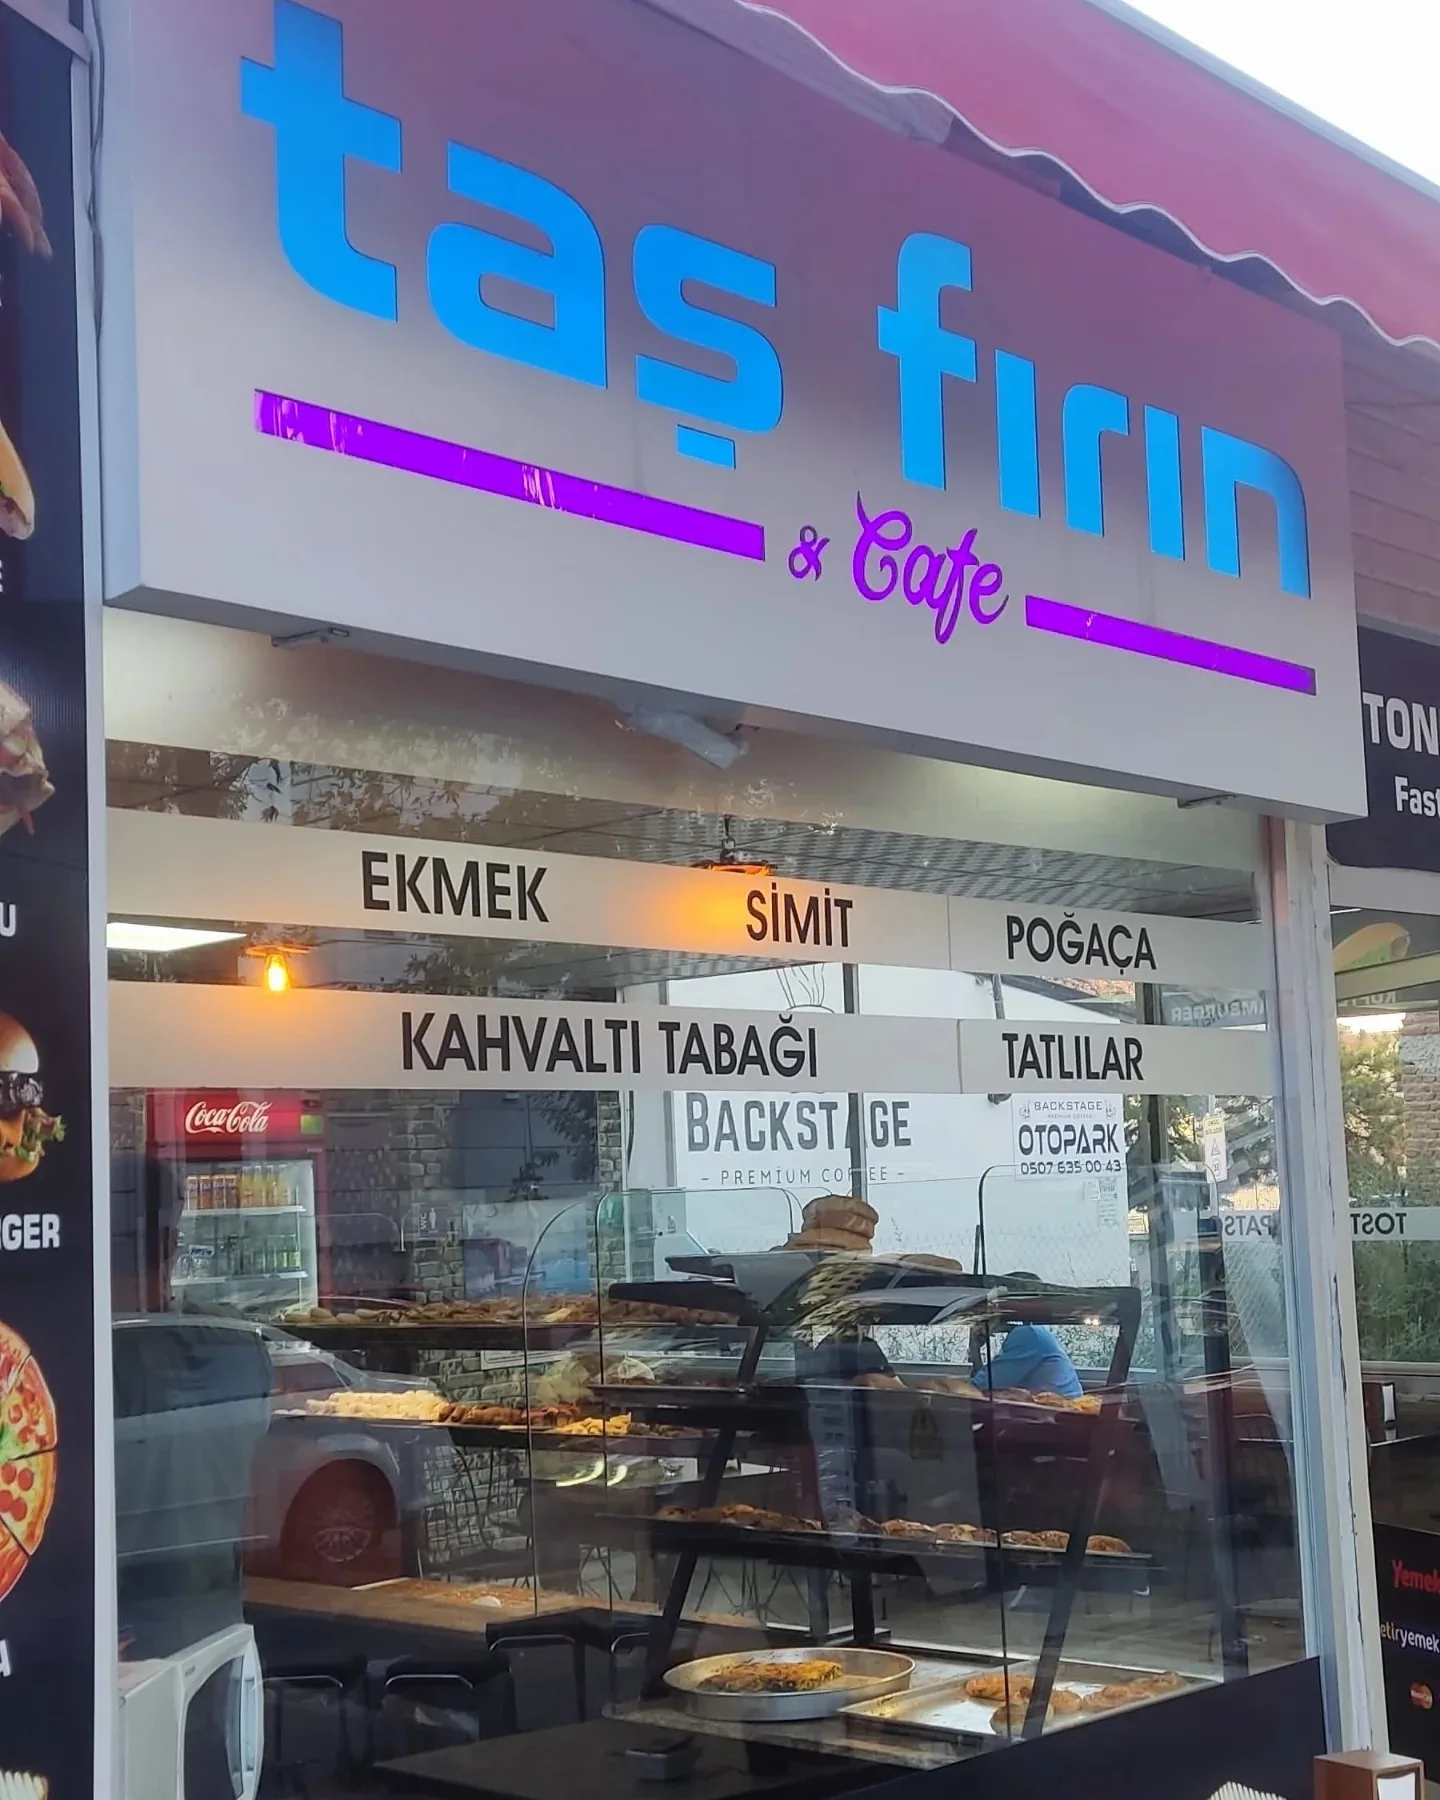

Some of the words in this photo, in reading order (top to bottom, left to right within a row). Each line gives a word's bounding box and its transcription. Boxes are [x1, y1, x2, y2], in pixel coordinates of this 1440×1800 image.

[240, 0, 783, 469] taş
[878, 231, 1311, 599] fırın
[789, 525, 830, 581] &
[853, 490, 1009, 645] Cafe
[362, 850, 549, 923] EKMEK
[747, 882, 853, 948] SİMİT
[1006, 911, 1157, 975] POĞAÇA
[402, 1011, 642, 1074] KAHVALTI
[658, 1015, 818, 1078] TABAĞI
[1002, 1032, 1144, 1081] TATLILAR
[185, 1101, 273, 1134] Coca-Cola
[686, 1092, 912, 1152] BACKSTGE
[1034, 1101, 1103, 1111] BACKSTAGE
[1018, 1123, 1120, 1156] OTOPARK
[720, 1166, 811, 1185] PREMİUM
[821, 1166, 888, 1183] COFEE
[1020, 1162, 1053, 1175] 0507
[1057, 1161, 1082, 1174] 635
[1085, 1160, 1101, 1173] 00
[1105, 1159, 1121, 1172] 43
[0, 1213, 60, 1250] GER
